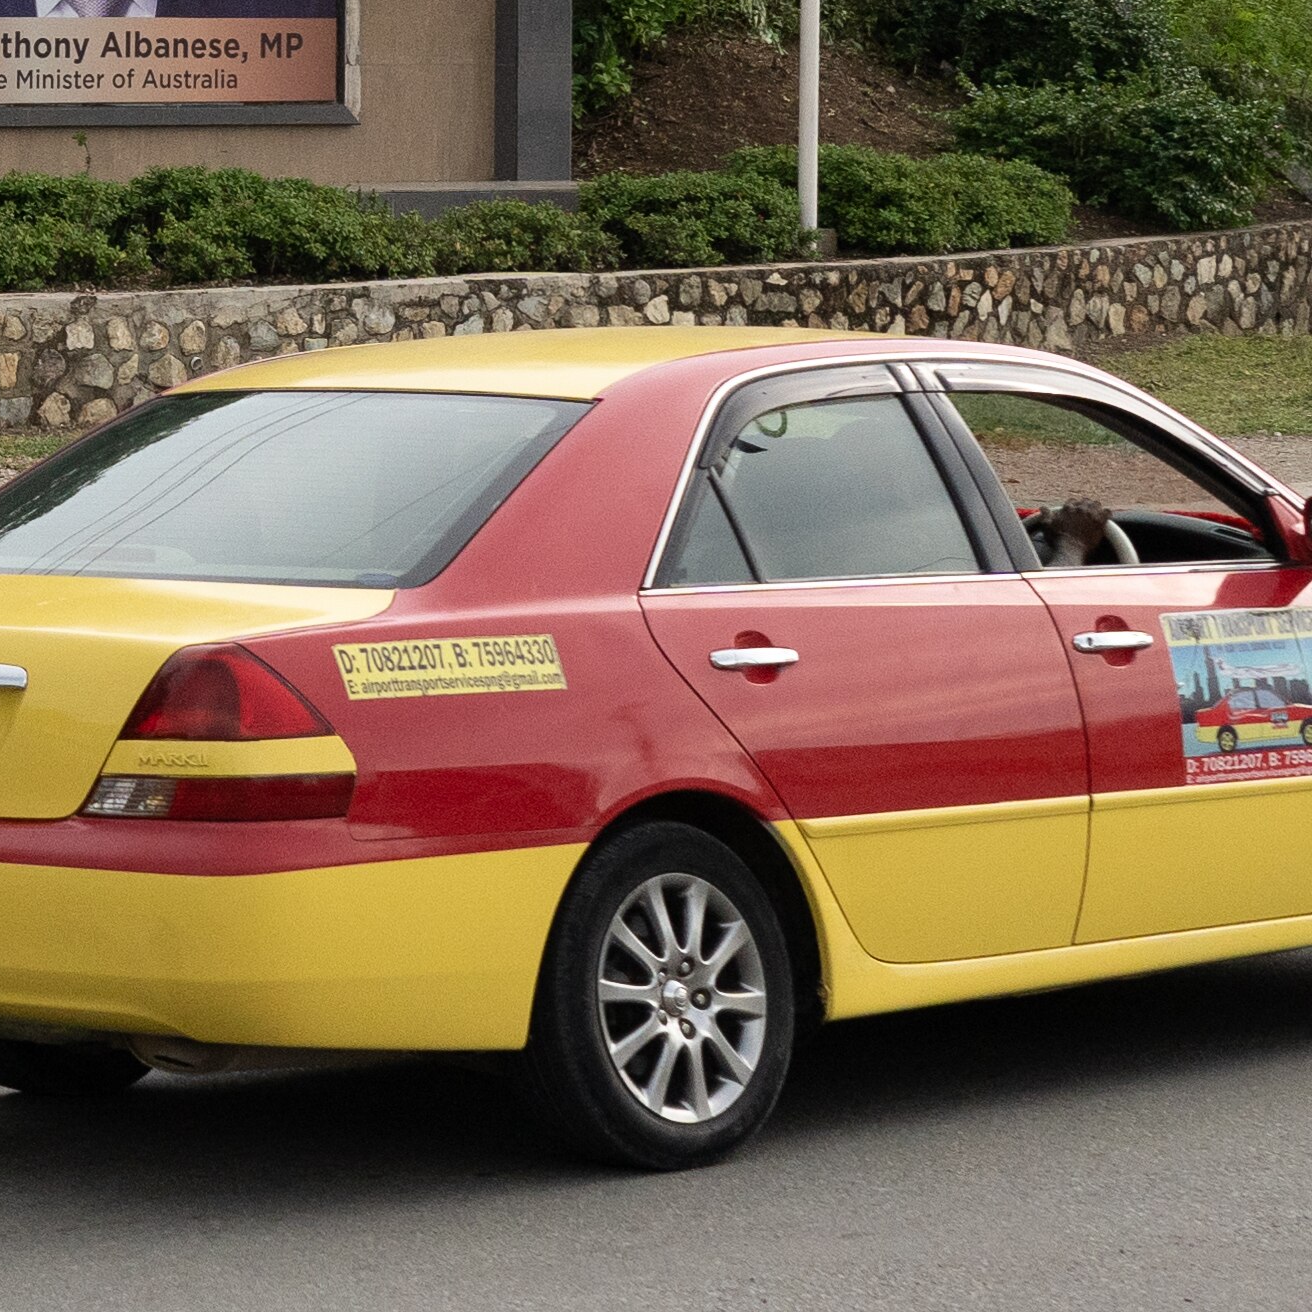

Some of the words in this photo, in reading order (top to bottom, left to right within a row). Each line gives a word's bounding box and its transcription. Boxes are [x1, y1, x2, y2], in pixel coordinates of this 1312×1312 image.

[100, 31, 248, 63] Albanese,
[260, 32, 304, 59] MP
[16, 69, 105, 90] Minister
[112, 68, 135, 89] of
[142, 68, 238, 89] Australia
[338, 649, 360, 674] D:
[359, 643, 454, 674] 70821207,
[452, 642, 473, 668] B:
[472, 639, 556, 667] 75964330
[347, 679, 360, 694] E:
